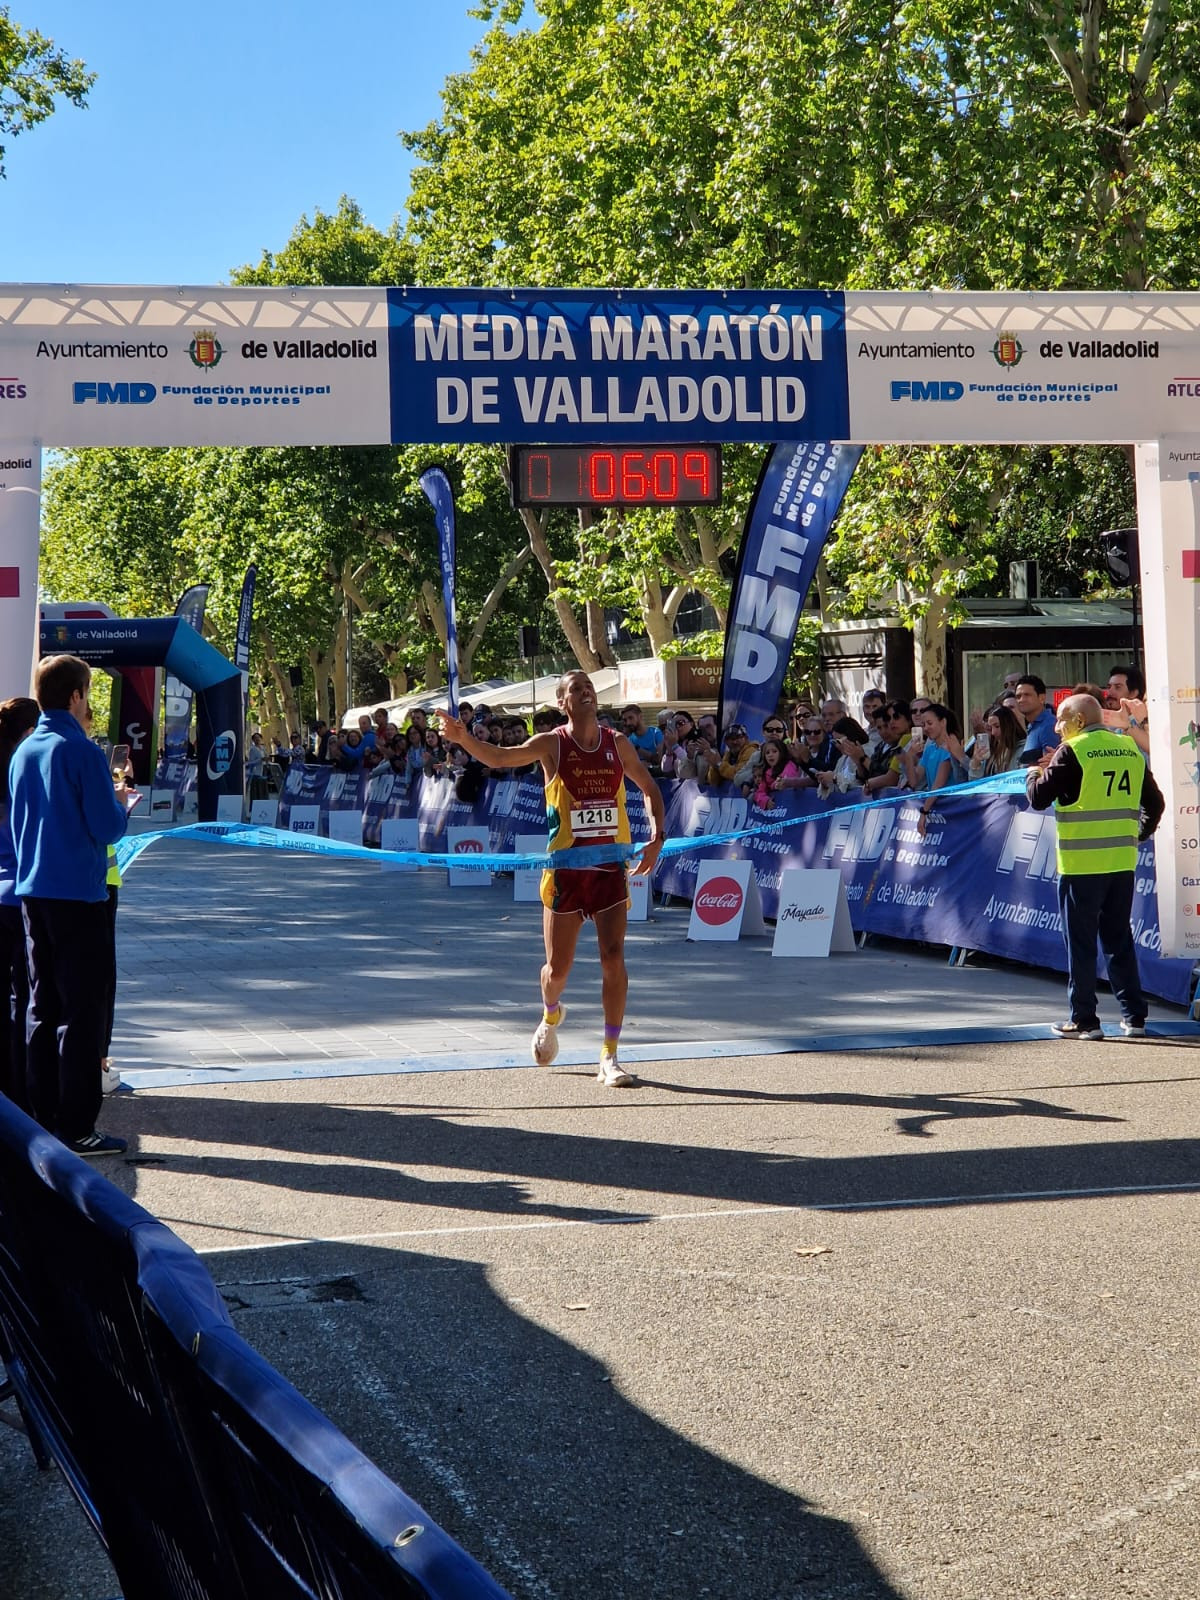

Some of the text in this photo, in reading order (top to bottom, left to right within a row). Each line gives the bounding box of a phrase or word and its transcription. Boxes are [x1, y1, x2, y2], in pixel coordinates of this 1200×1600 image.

[415, 304, 823, 361] MEDIA MARATÓN
[36, 340, 377, 360] Ayuntamiento de Valladolid
[858, 341, 1160, 360] Ayuntamiento de Valladolid
[72, 382, 156, 404] FMD
[162, 385, 331, 395] Fundación Municipal
[890, 381, 964, 402] FMD
[969, 383, 1118, 393] Fundación Municipal
[193, 395, 301, 406] de Deportes
[436, 375, 806, 424] DE VALLADOLID
[997, 393, 1092, 403] de Deportes
[801, 502, 817, 527] de
[731, 524, 809, 686] FMD
[77, 630, 138, 639] de Valladolid
[584, 778, 605, 787] VINO
[1103, 769, 1132, 797] 74
[293, 820, 315, 832] gaza
[577, 809, 612, 824] 1218
[877, 881, 891, 902] de
[892, 883, 940, 907] Valladolid
